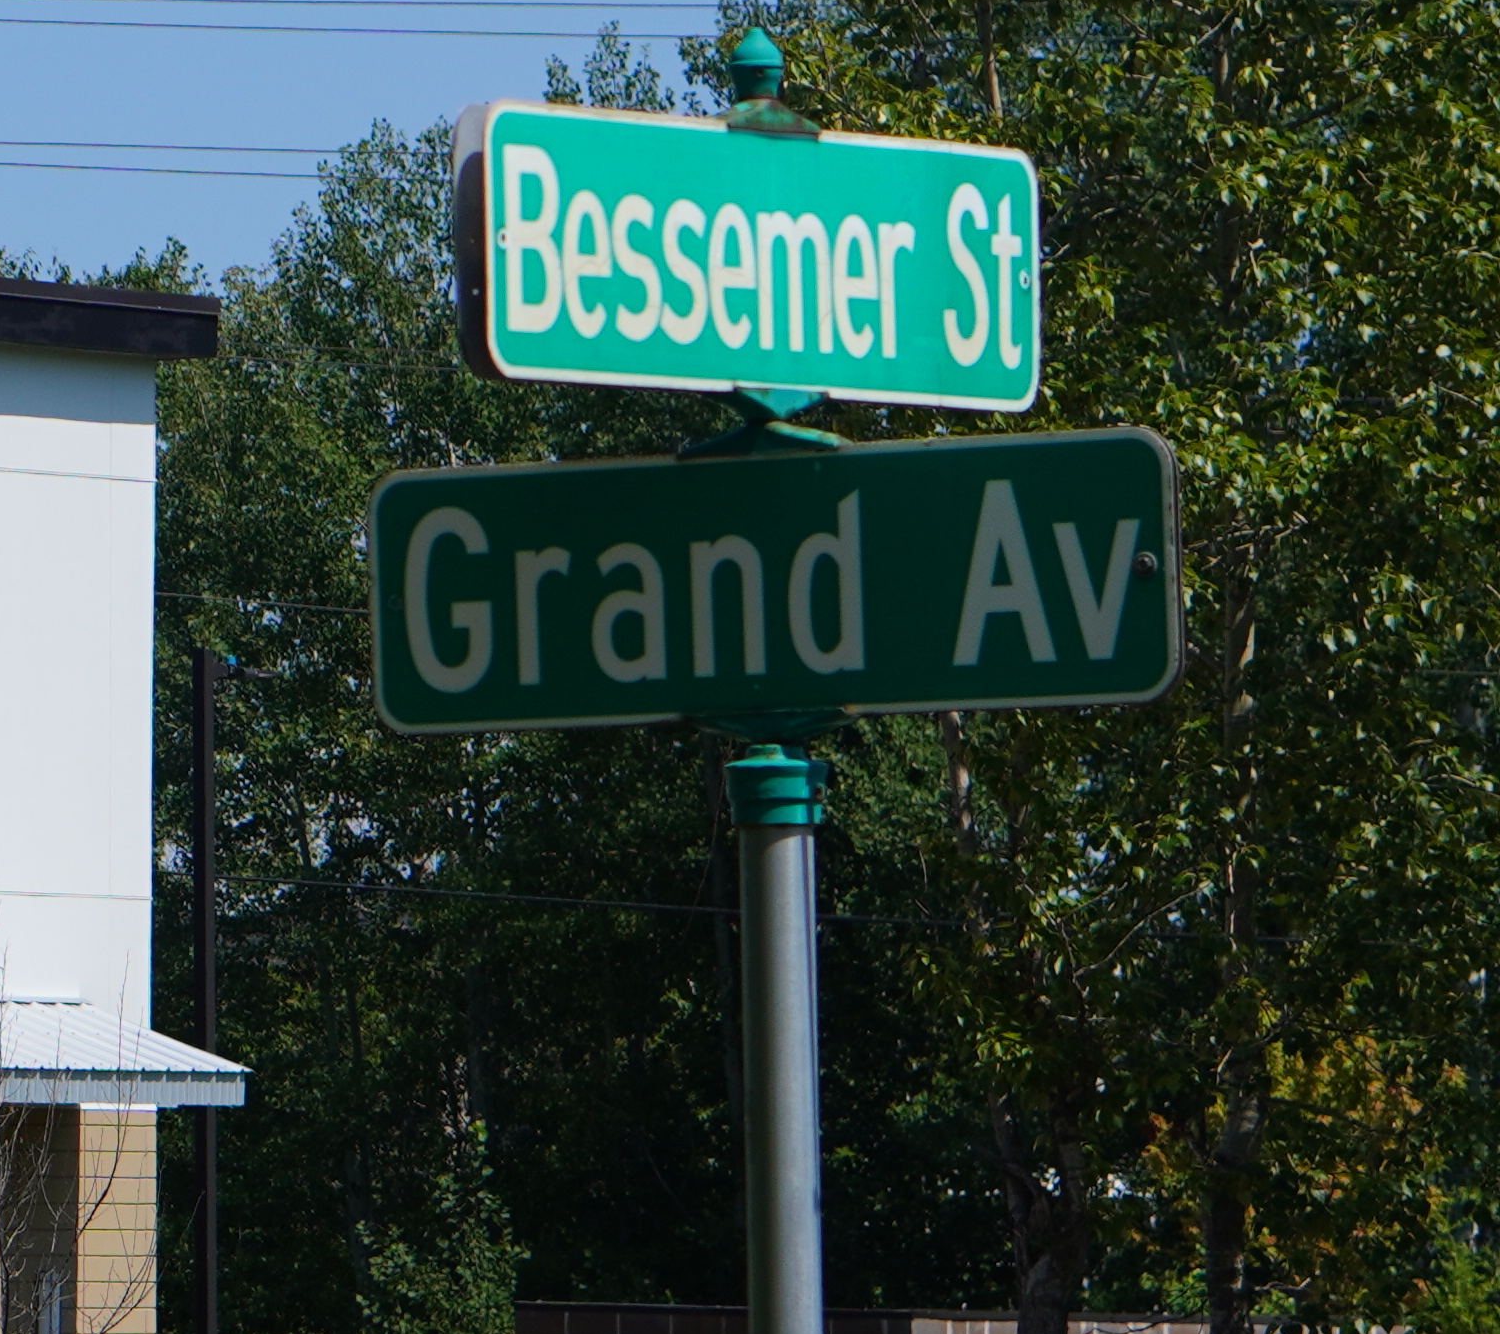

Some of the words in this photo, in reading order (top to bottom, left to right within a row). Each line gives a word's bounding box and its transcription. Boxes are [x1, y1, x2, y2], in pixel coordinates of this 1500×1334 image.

[503, 144, 916, 360] Bessemer
[943, 182, 1023, 371] St
[403, 489, 867, 694] Grand
[953, 479, 1141, 667] Av
